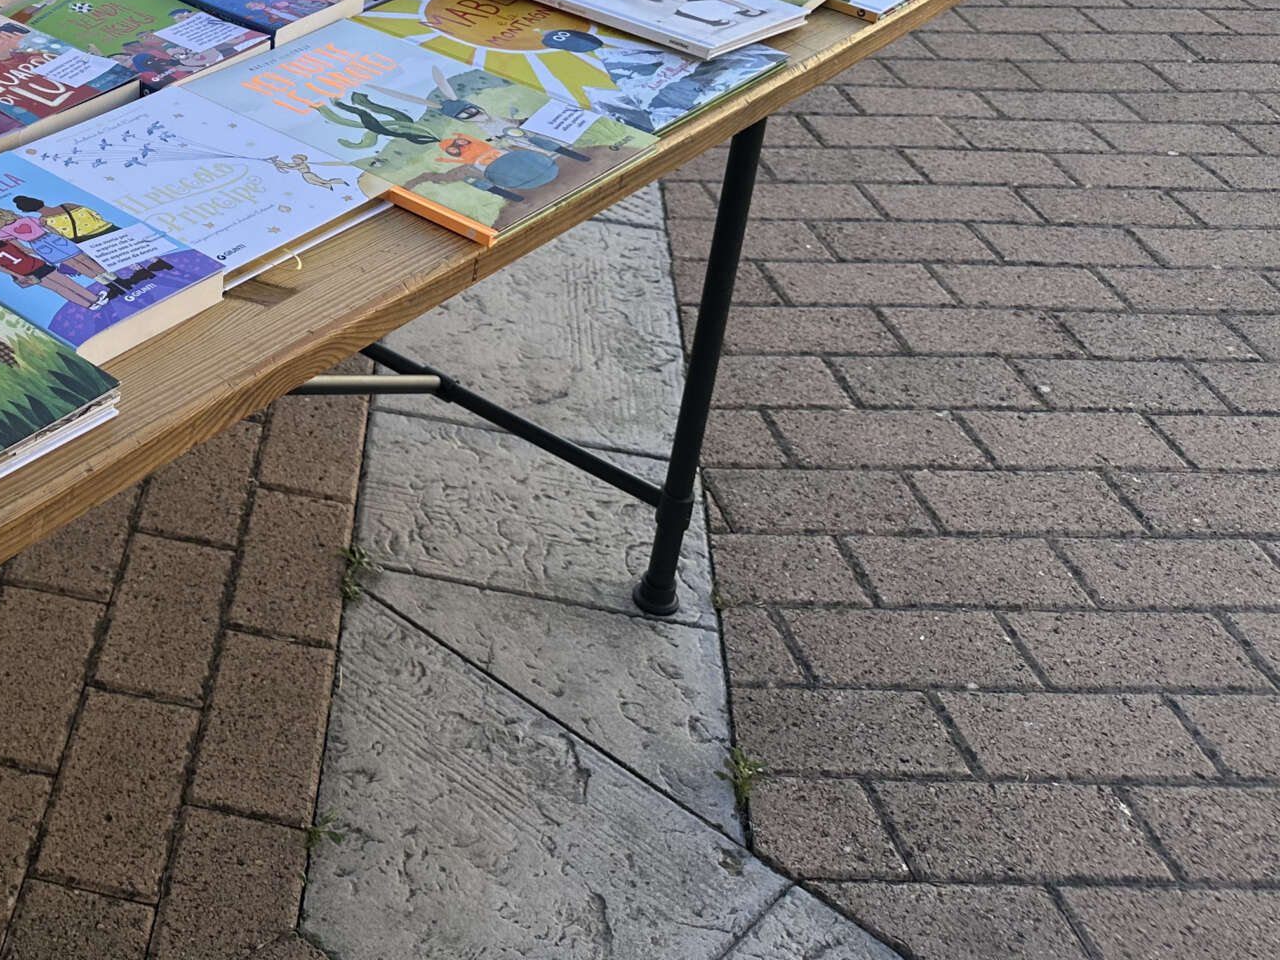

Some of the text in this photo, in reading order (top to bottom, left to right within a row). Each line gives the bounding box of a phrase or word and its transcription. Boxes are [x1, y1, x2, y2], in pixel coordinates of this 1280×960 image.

[486, 7, 554, 46] MONTAGN
[8, 78, 76, 108] LU
[130, 282, 158, 298] GIUNTI
